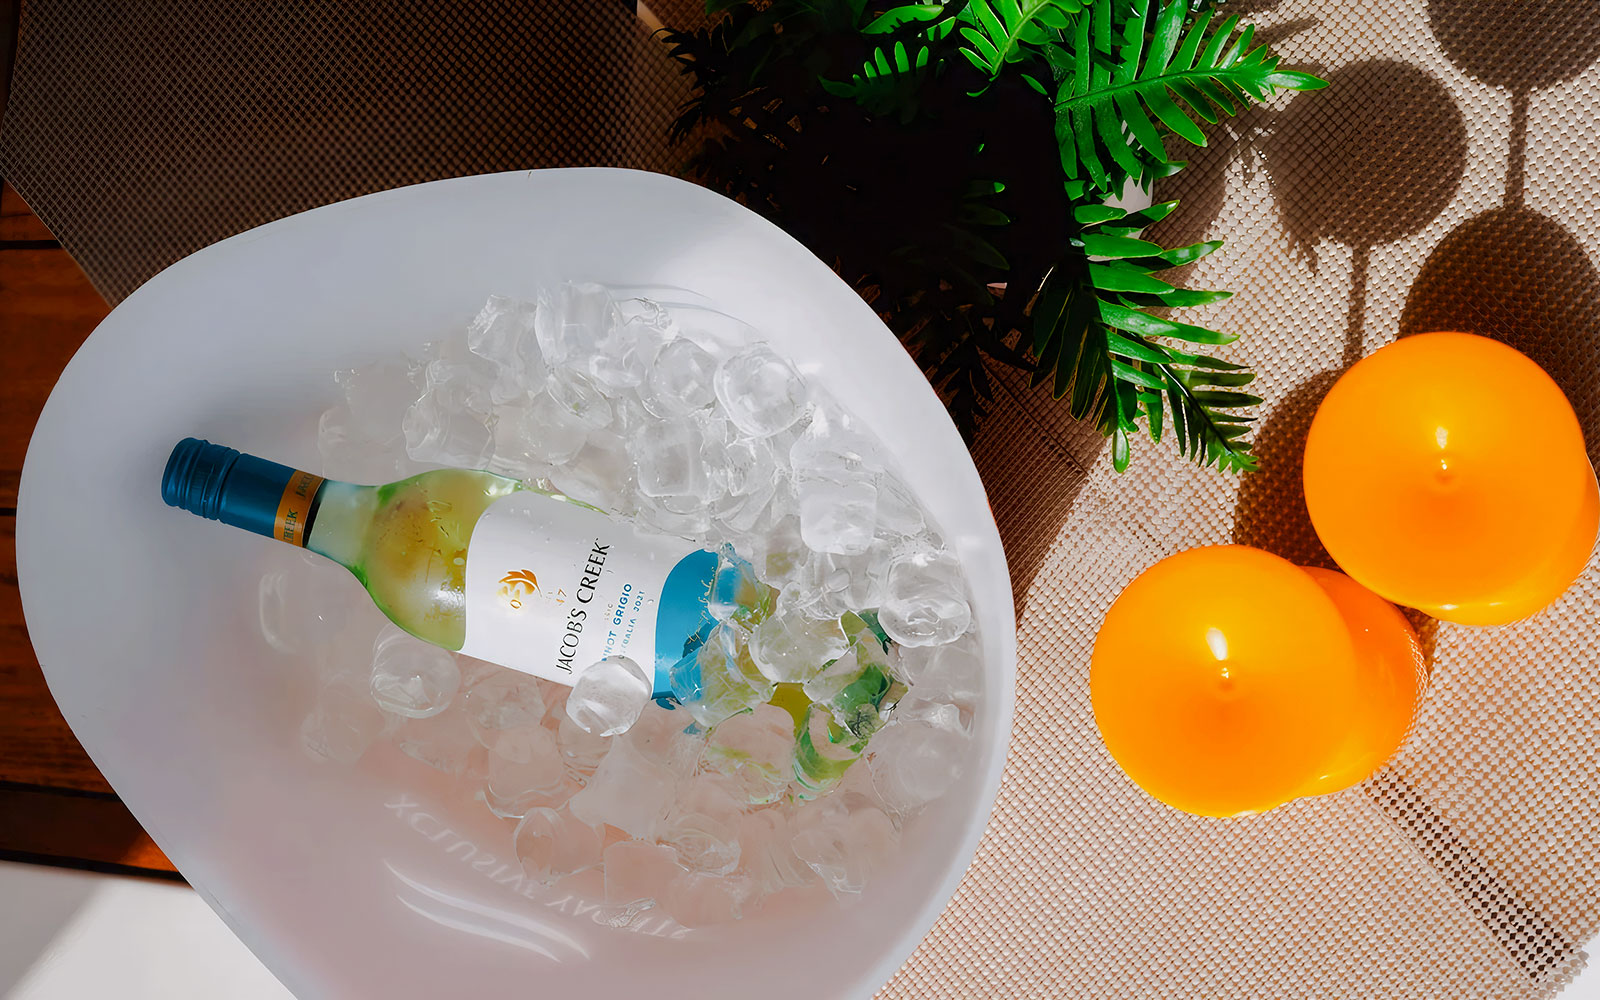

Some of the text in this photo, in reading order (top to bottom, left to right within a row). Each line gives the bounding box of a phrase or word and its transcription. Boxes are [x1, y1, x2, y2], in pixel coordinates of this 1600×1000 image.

[556, 540, 610, 675] JACOB'S CREEK
[612, 583, 632, 625] GRIGIO
